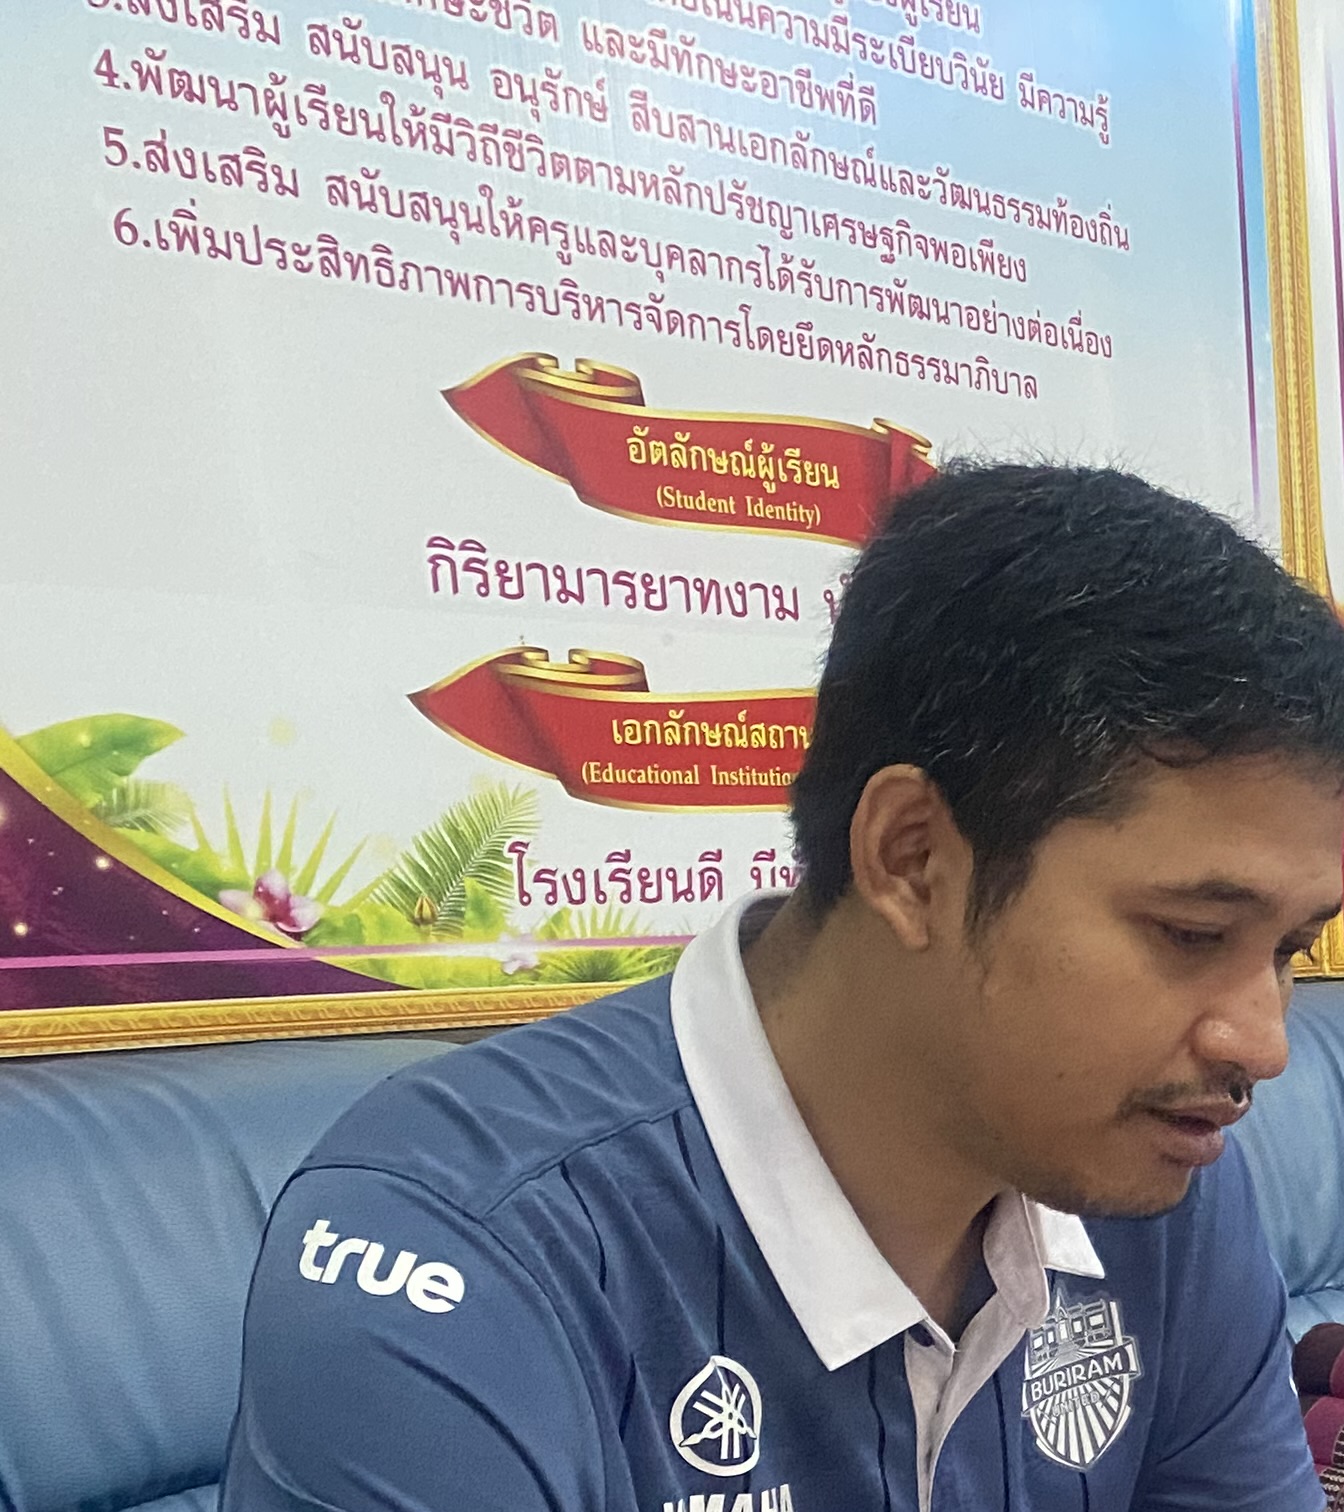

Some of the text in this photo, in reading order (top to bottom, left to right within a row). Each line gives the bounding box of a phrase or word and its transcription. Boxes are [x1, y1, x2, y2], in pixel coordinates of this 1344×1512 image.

[306, 17, 470, 99] สนับสนุน
[489, 67, 610, 123] อนุรักษ์
[1018, 74, 1111, 145] มีความรู้
[625, 426, 841, 493] อัตลักษณ์ผู้เรียน
[655, 485, 822, 527] (Student Identity)
[426, 536, 800, 622] กิริยามารยาทงาม
[580, 762, 700, 788] (Educational
[507, 839, 725, 907] โรงเรียนดี
[299, 1219, 465, 1314] true
[1030, 1352, 1124, 1402] BURIRAM
